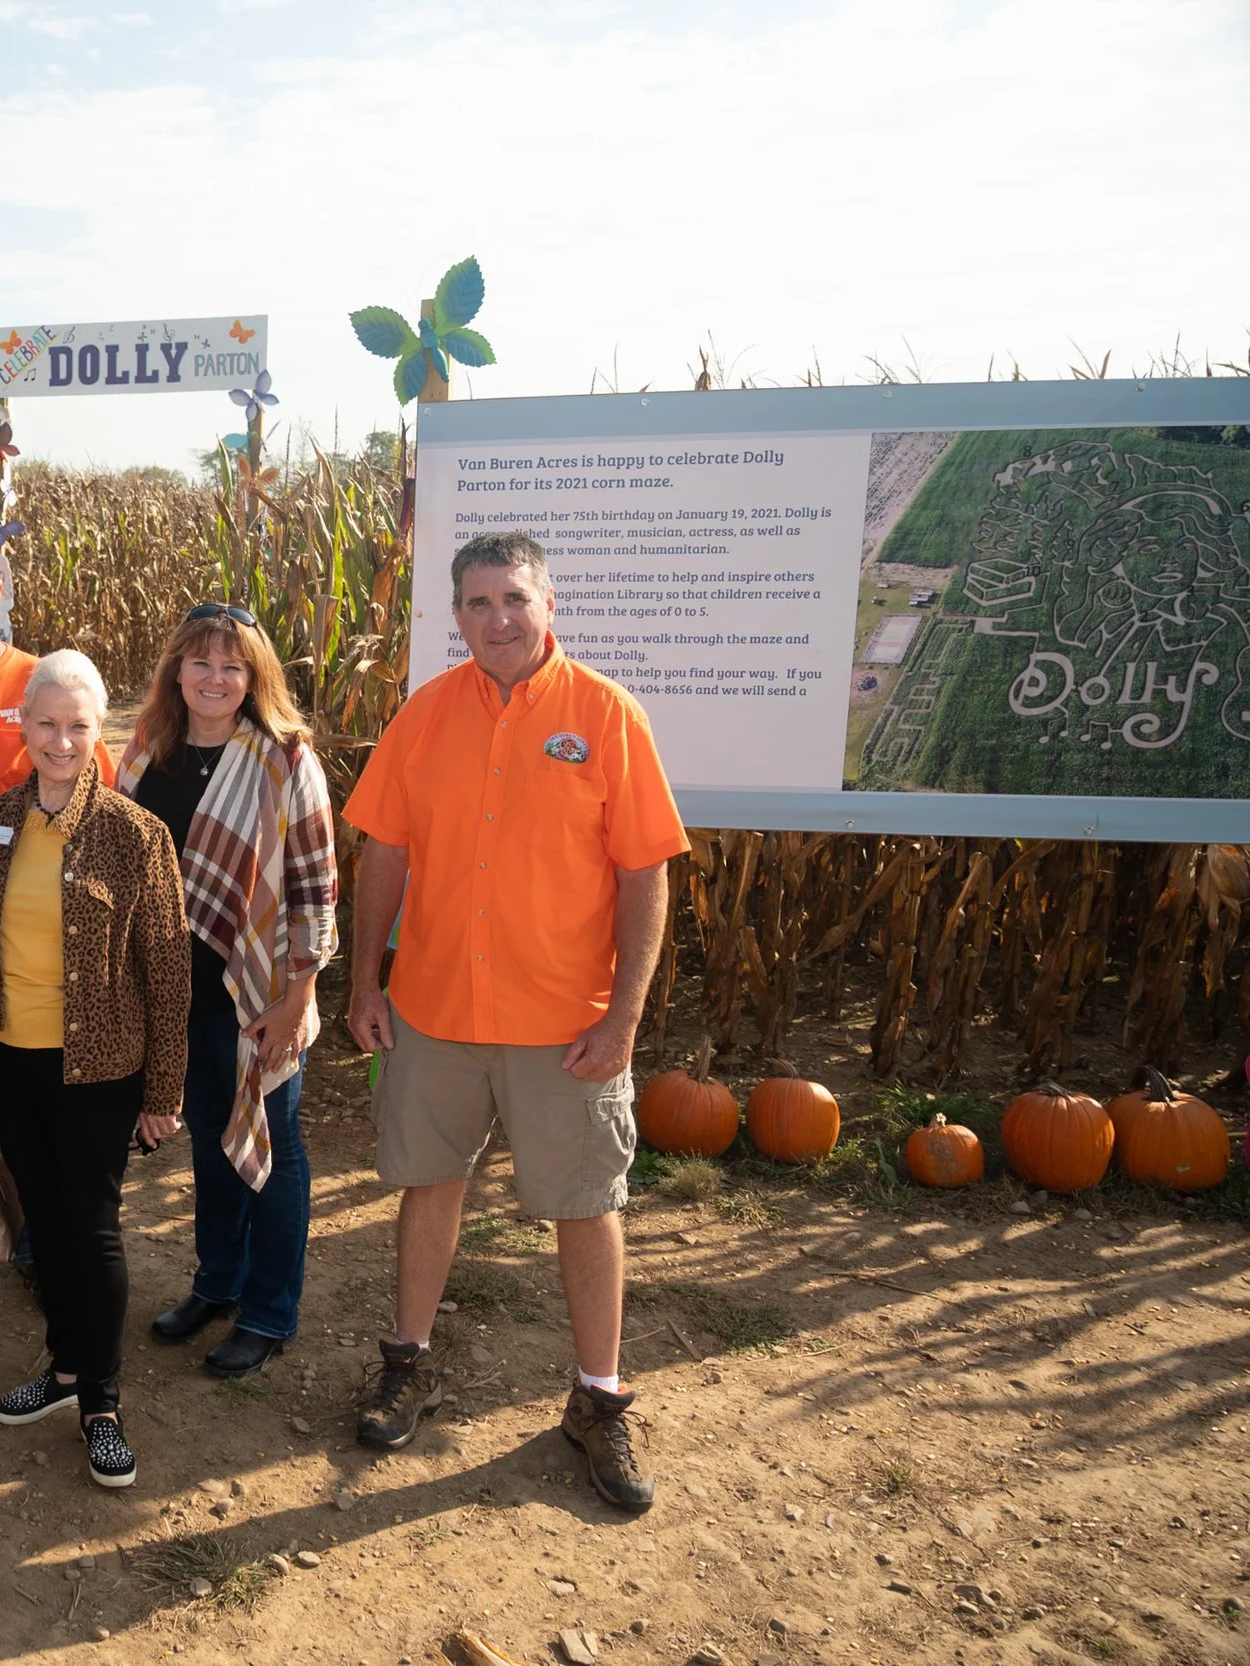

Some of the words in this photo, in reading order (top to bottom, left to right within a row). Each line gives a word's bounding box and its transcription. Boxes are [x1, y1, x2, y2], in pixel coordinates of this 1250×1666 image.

[48, 341, 189, 387] DOLLY
[194, 352, 260, 377] PARTON
[1023, 445, 1032, 457] 8
[458, 459, 486, 470] Van
[490, 458, 533, 469] Buren
[536, 457, 577, 468] Acres
[582, 455, 593, 467] is
[597, 455, 644, 469] happy
[649, 454, 663, 465] to
[668, 452, 739, 465] celebrate
[743, 450, 783, 466] Dolly
[458, 480, 505, 491] Parton
[510, 478, 531, 490] for
[534, 478, 552, 490] its
[556, 478, 588, 489] 2021
[592, 479, 625, 488] corn
[630, 478, 673, 487] maze.
[1110, 481, 1120, 492] 7
[456, 513, 484, 525] Dolly
[487, 511, 547, 522] celebrated
[550, 511, 570, 521] her
[573, 511, 598, 521] 75th
[602, 510, 654, 522] birthday
[658, 512, 673, 520] on
[676, 510, 728, 521] January
[732, 509, 747, 520] 19,
[751, 509, 781, 518] 2021.
[785, 507, 818, 520] Dolly
[821, 507, 831, 517] is
[455, 532, 470, 540] an
[555, 528, 624, 540] songwriter,
[627, 527, 685, 538] musician,
[689, 528, 736, 537] actress,
[740, 528, 754, 536] as
[757, 525, 782, 536] well
[786, 525, 800, 535] as
[567, 547, 610, 555] woman
[614, 544, 636, 555] and
[640, 544, 729, 554] humanitarian.
[586, 572, 605, 582] her
[609, 572, 654, 582] lifetime
[658, 574, 669, 582] to
[672, 572, 698, 584] help
[701, 572, 724, 582] and
[728, 572, 771, 584] inspire
[774, 571, 814, 582] others
[553, 588, 615, 602] agination
[618, 589, 663, 602] Library
[683, 589, 707, 599] that
[711, 589, 762, 599] children
[766, 589, 810, 599] receive
[813, 591, 820, 599] a
[554, 606, 573, 616] nth
[577, 606, 604, 616] from
[608, 606, 627, 616] the
[630, 609, 657, 618] ages
[660, 606, 672, 616] of
[675, 607, 682, 616] 0
[685, 608, 696, 616] to
[700, 607, 709, 616] 5.
[556, 634, 575, 643] ave
[578, 633, 598, 643] fun
[617, 636, 638, 646] you
[642, 633, 671, 643] walk
[675, 634, 723, 646] through
[727, 634, 747, 644] the
[750, 636, 782, 644] maze
[785, 634, 809, 644] and
[447, 647, 470, 658] find
[578, 650, 611, 660] about
[615, 650, 648, 663] Dolly.
[622, 669, 633, 677] to
[636, 667, 661, 680] help
[664, 670, 686, 680] you
[690, 668, 714, 678] find
[717, 671, 746, 680] your
[749, 671, 777, 681] way.
[787, 668, 797, 678] If
[799, 671, 821, 681] you
[623, 684, 693, 695] 0-404-8656
[696, 685, 718, 695] and
[742, 685, 764, 695] will
[767, 686, 796, 696] send
[1008, 652, 1220, 749] Dolly
